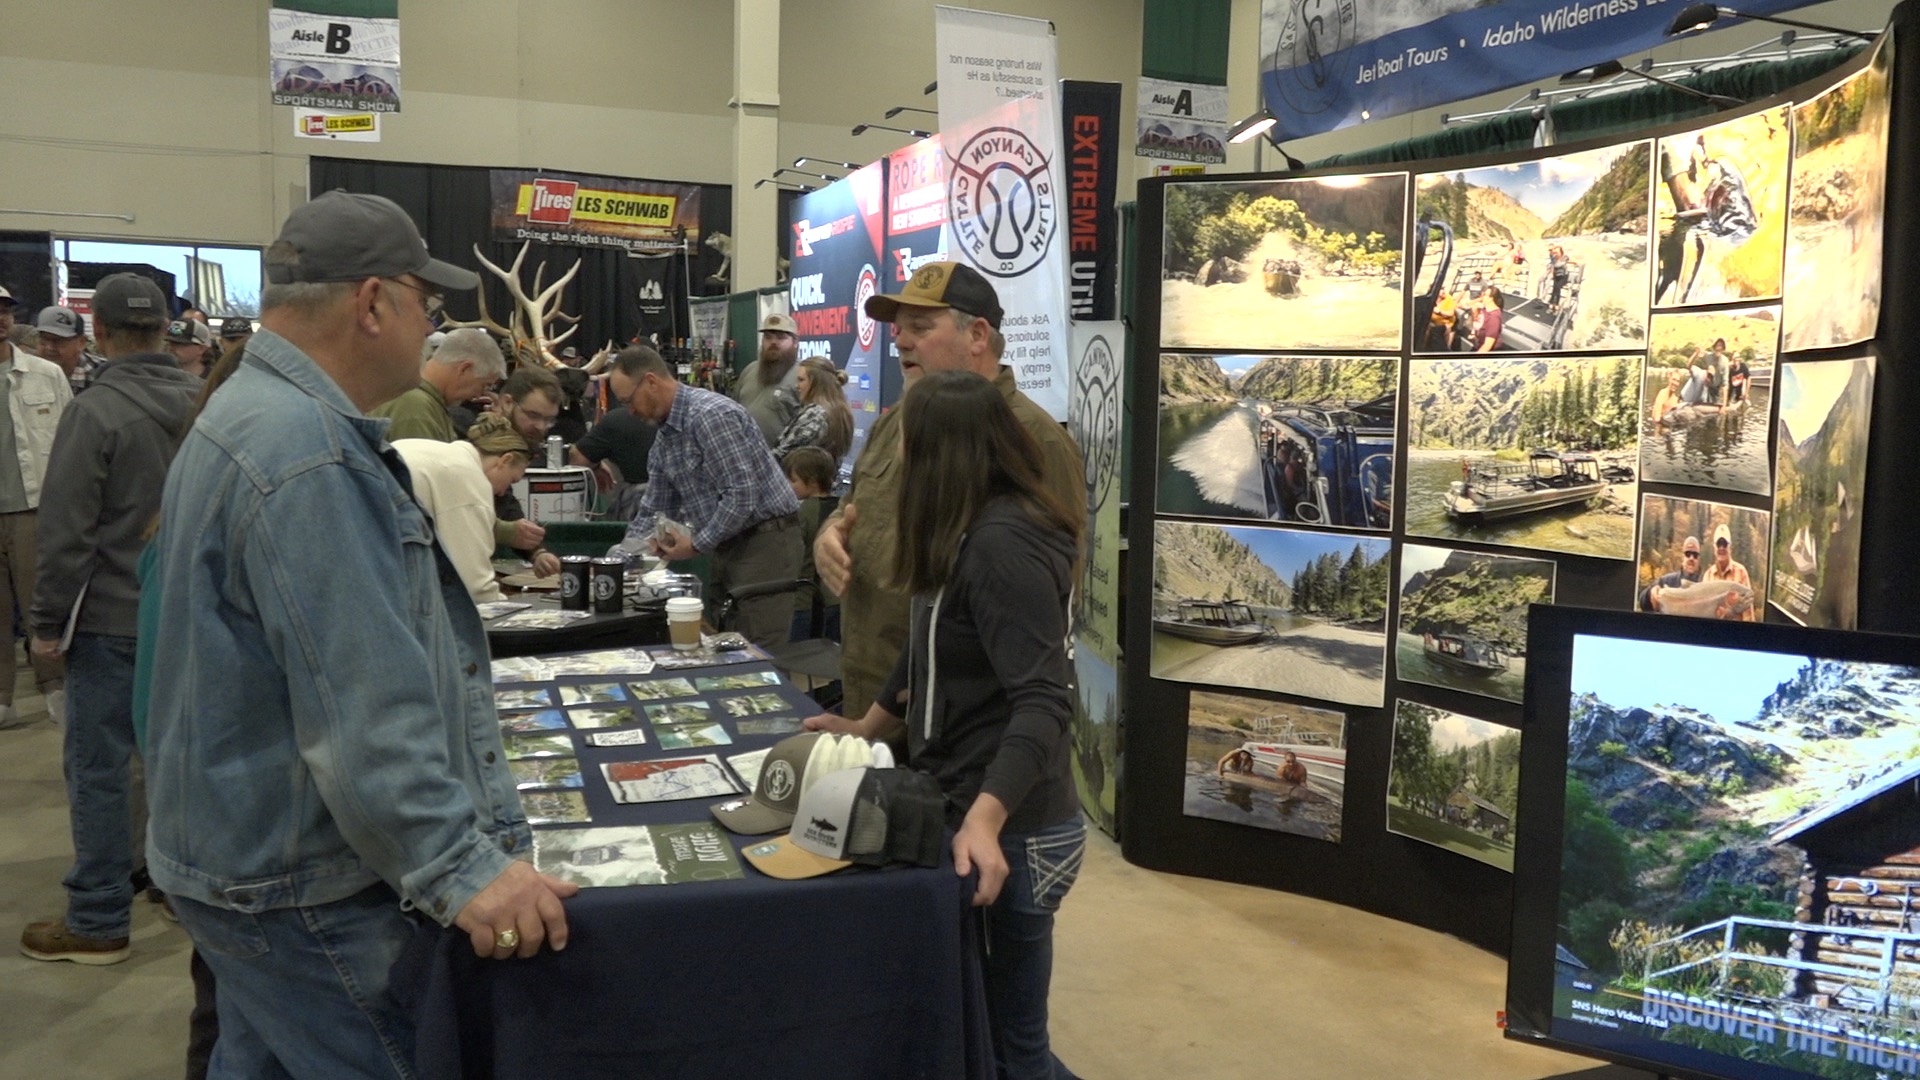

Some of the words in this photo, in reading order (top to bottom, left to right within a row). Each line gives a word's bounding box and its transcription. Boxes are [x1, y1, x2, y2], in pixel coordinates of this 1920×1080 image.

[291, 29, 325, 43] Aisle
[325, 22, 352, 55] B
[1355, 64, 1377, 84] Jet
[1377, 53, 1403, 78] Boat
[1406, 46, 1449, 68] Tours
[1482, 21, 1535, 48] Idaho
[1540, 0, 1639, 35] Wilderness
[274, 94, 353, 109] SPORTSMAN
[358, 101, 396, 112] SHOW
[1152, 94, 1175, 106] Aisle
[1172, 89, 1192, 116] A
[1137, 147, 1192, 161] SPORTSMAN
[1195, 153, 1224, 163] SHOW
[1073, 115, 1100, 252] EXTREME
[534, 185, 573, 212] Tires
[576, 196, 602, 213] LES
[604, 199, 669, 219] SCHWAB
[516, 228, 549, 242] Doing
[552, 231, 569, 242] the
[571, 232, 599, 245] right
[602, 236, 631, 249] thing
[797, 340, 831, 360] TRONG
[1084, 347, 1111, 382] CANYON
[1571, 999, 1591, 1011] SNS
[1592, 1004, 1615, 1017] Hero
[1616, 1009, 1644, 1023] Video
[1645, 1016, 1669, 1028] Final
[1641, 987, 1776, 1045] DISCOVER
[1782, 1016, 1840, 1059] THE
